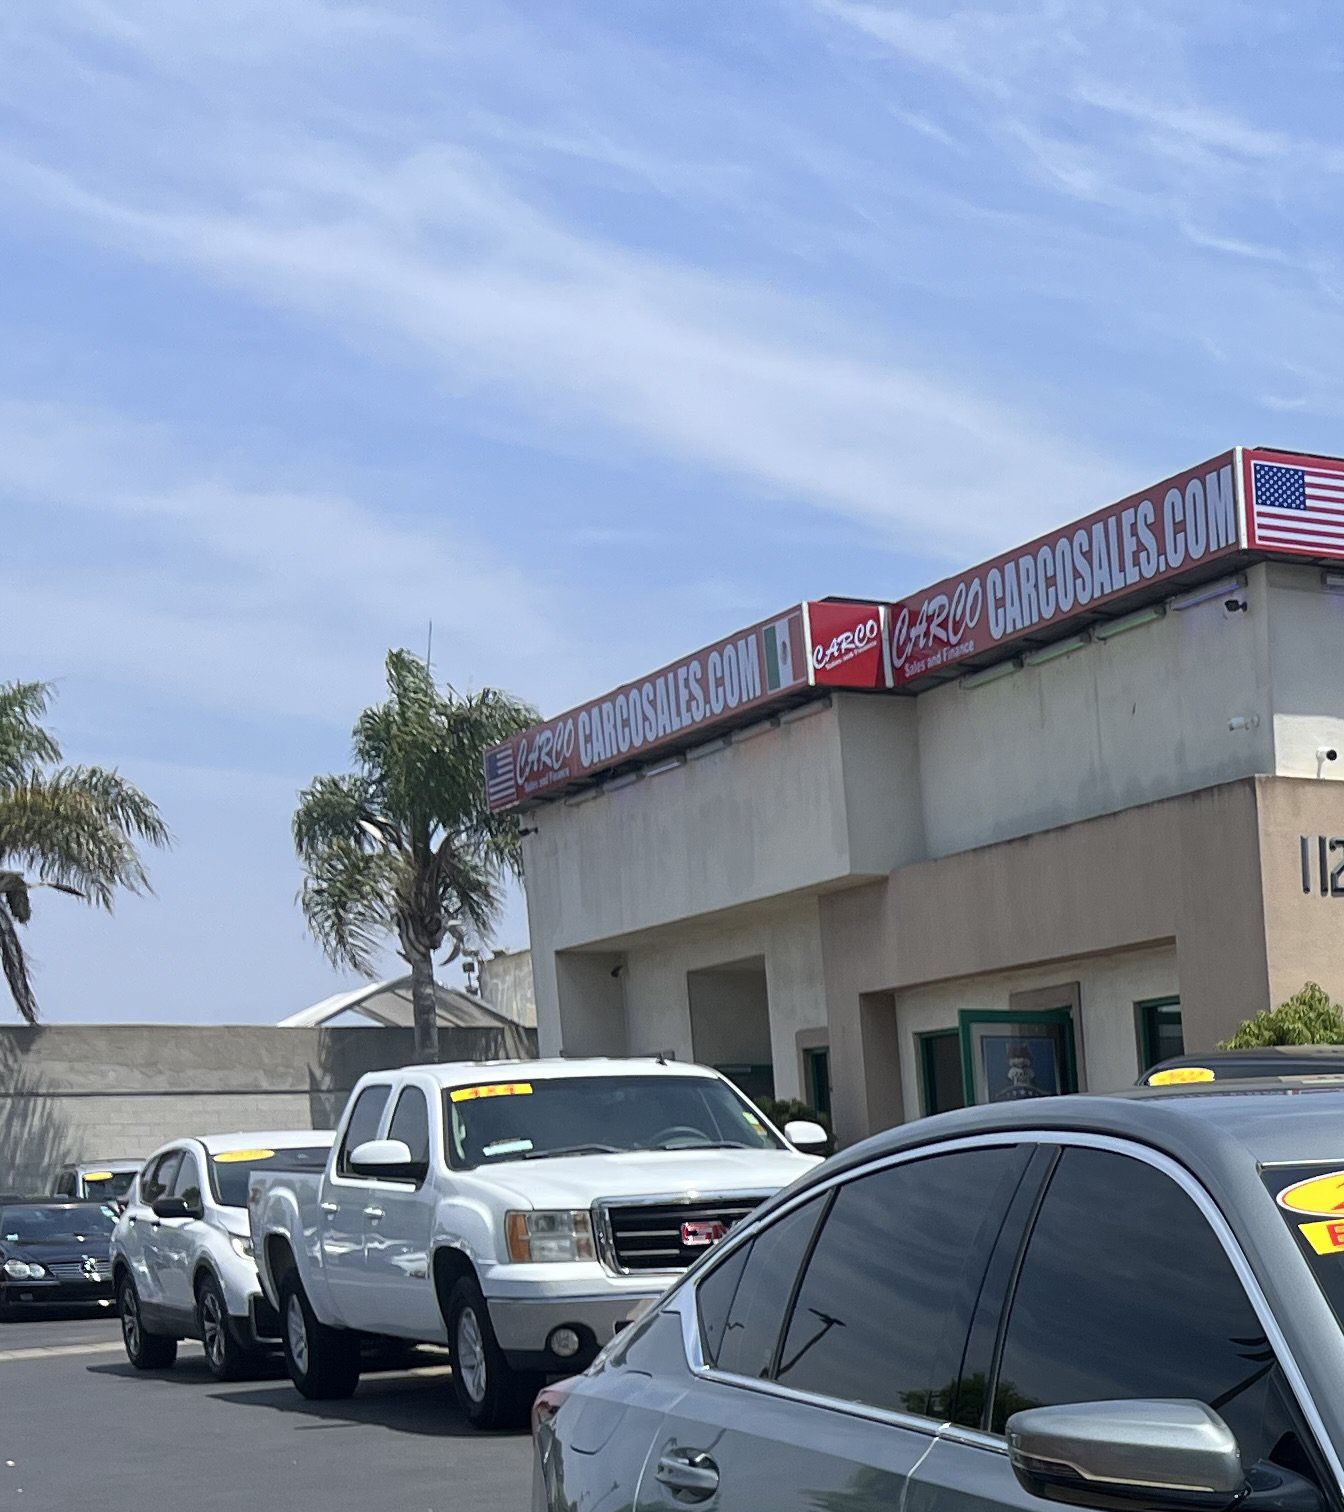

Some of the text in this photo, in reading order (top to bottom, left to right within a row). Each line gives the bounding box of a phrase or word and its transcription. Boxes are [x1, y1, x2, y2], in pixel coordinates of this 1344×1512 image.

[892, 463, 1236, 669] CARCO CARCOSALES.COM
[813, 619, 878, 670] CARCO
[904, 661, 926, 678] Sales
[941, 639, 975, 663] Finance
[516, 634, 762, 786] CARCO CARCOSALES.COM
[681, 1221, 741, 1246] GM
